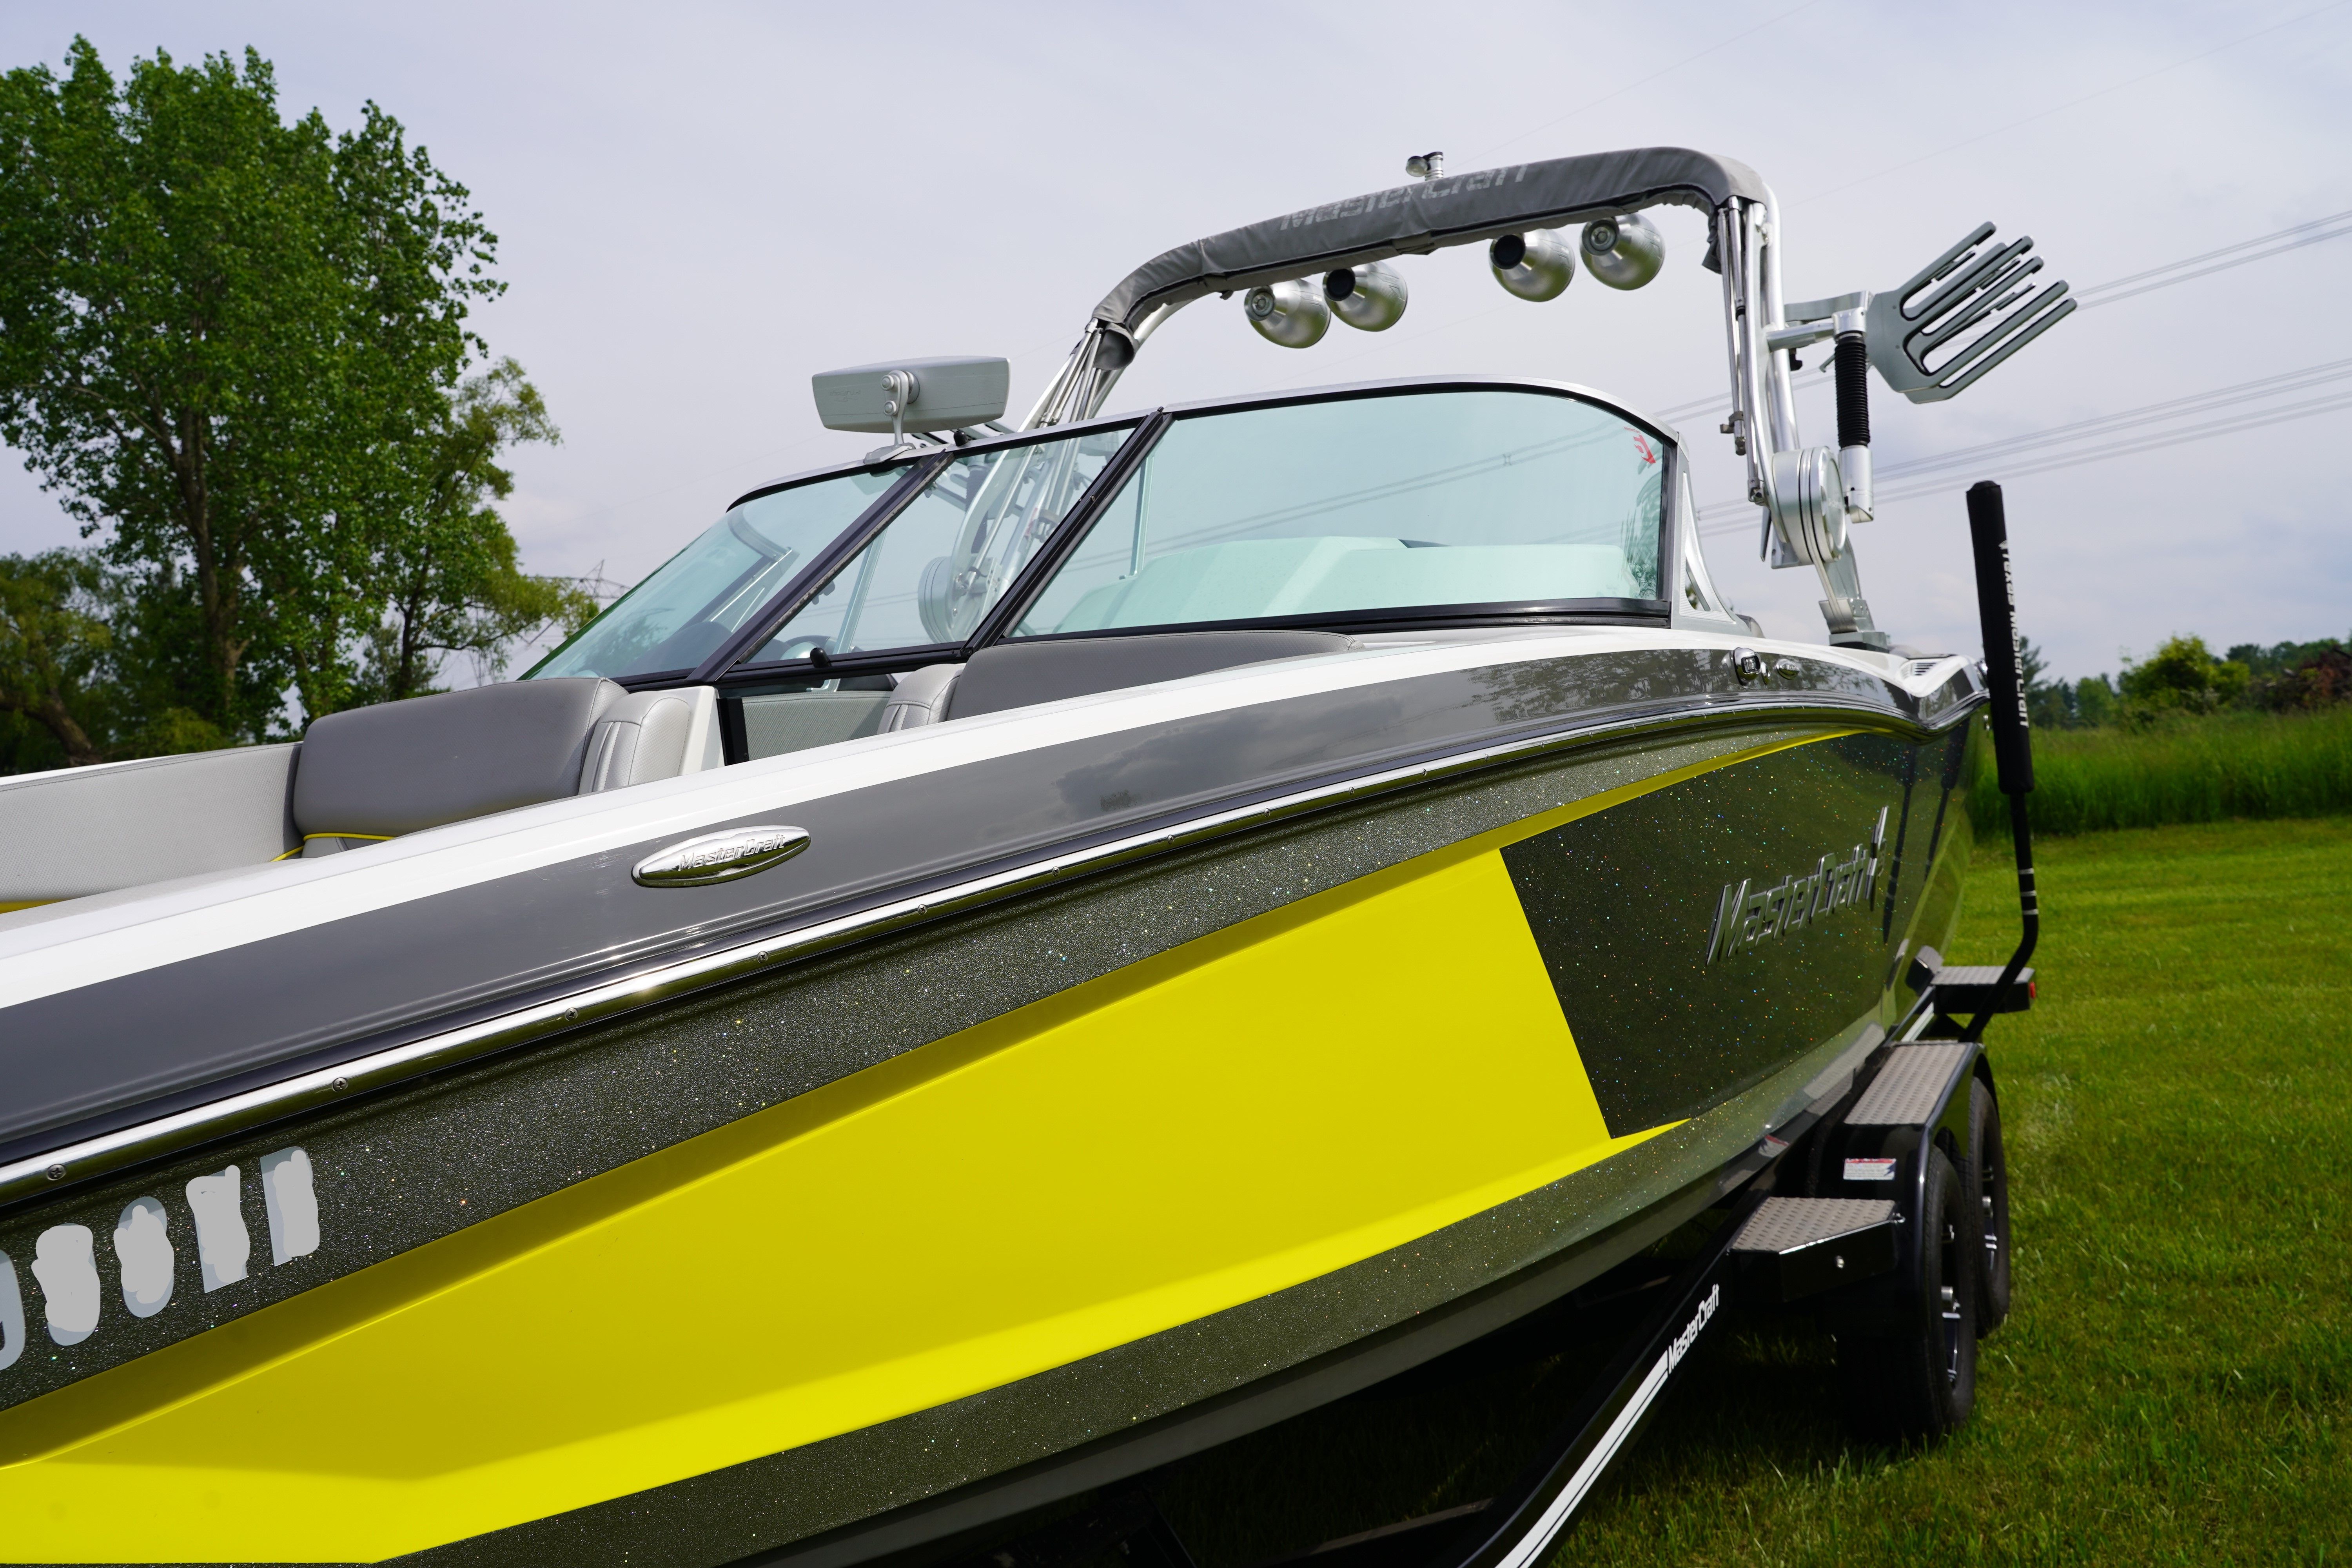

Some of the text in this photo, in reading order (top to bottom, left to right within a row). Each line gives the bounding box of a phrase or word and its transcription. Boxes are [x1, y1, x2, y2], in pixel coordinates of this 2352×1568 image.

[678, 834, 786, 871] MasterCraft
[1706, 843, 1868, 967] MasterCraft
[1668, 1283, 1720, 1374] MasterCraft
